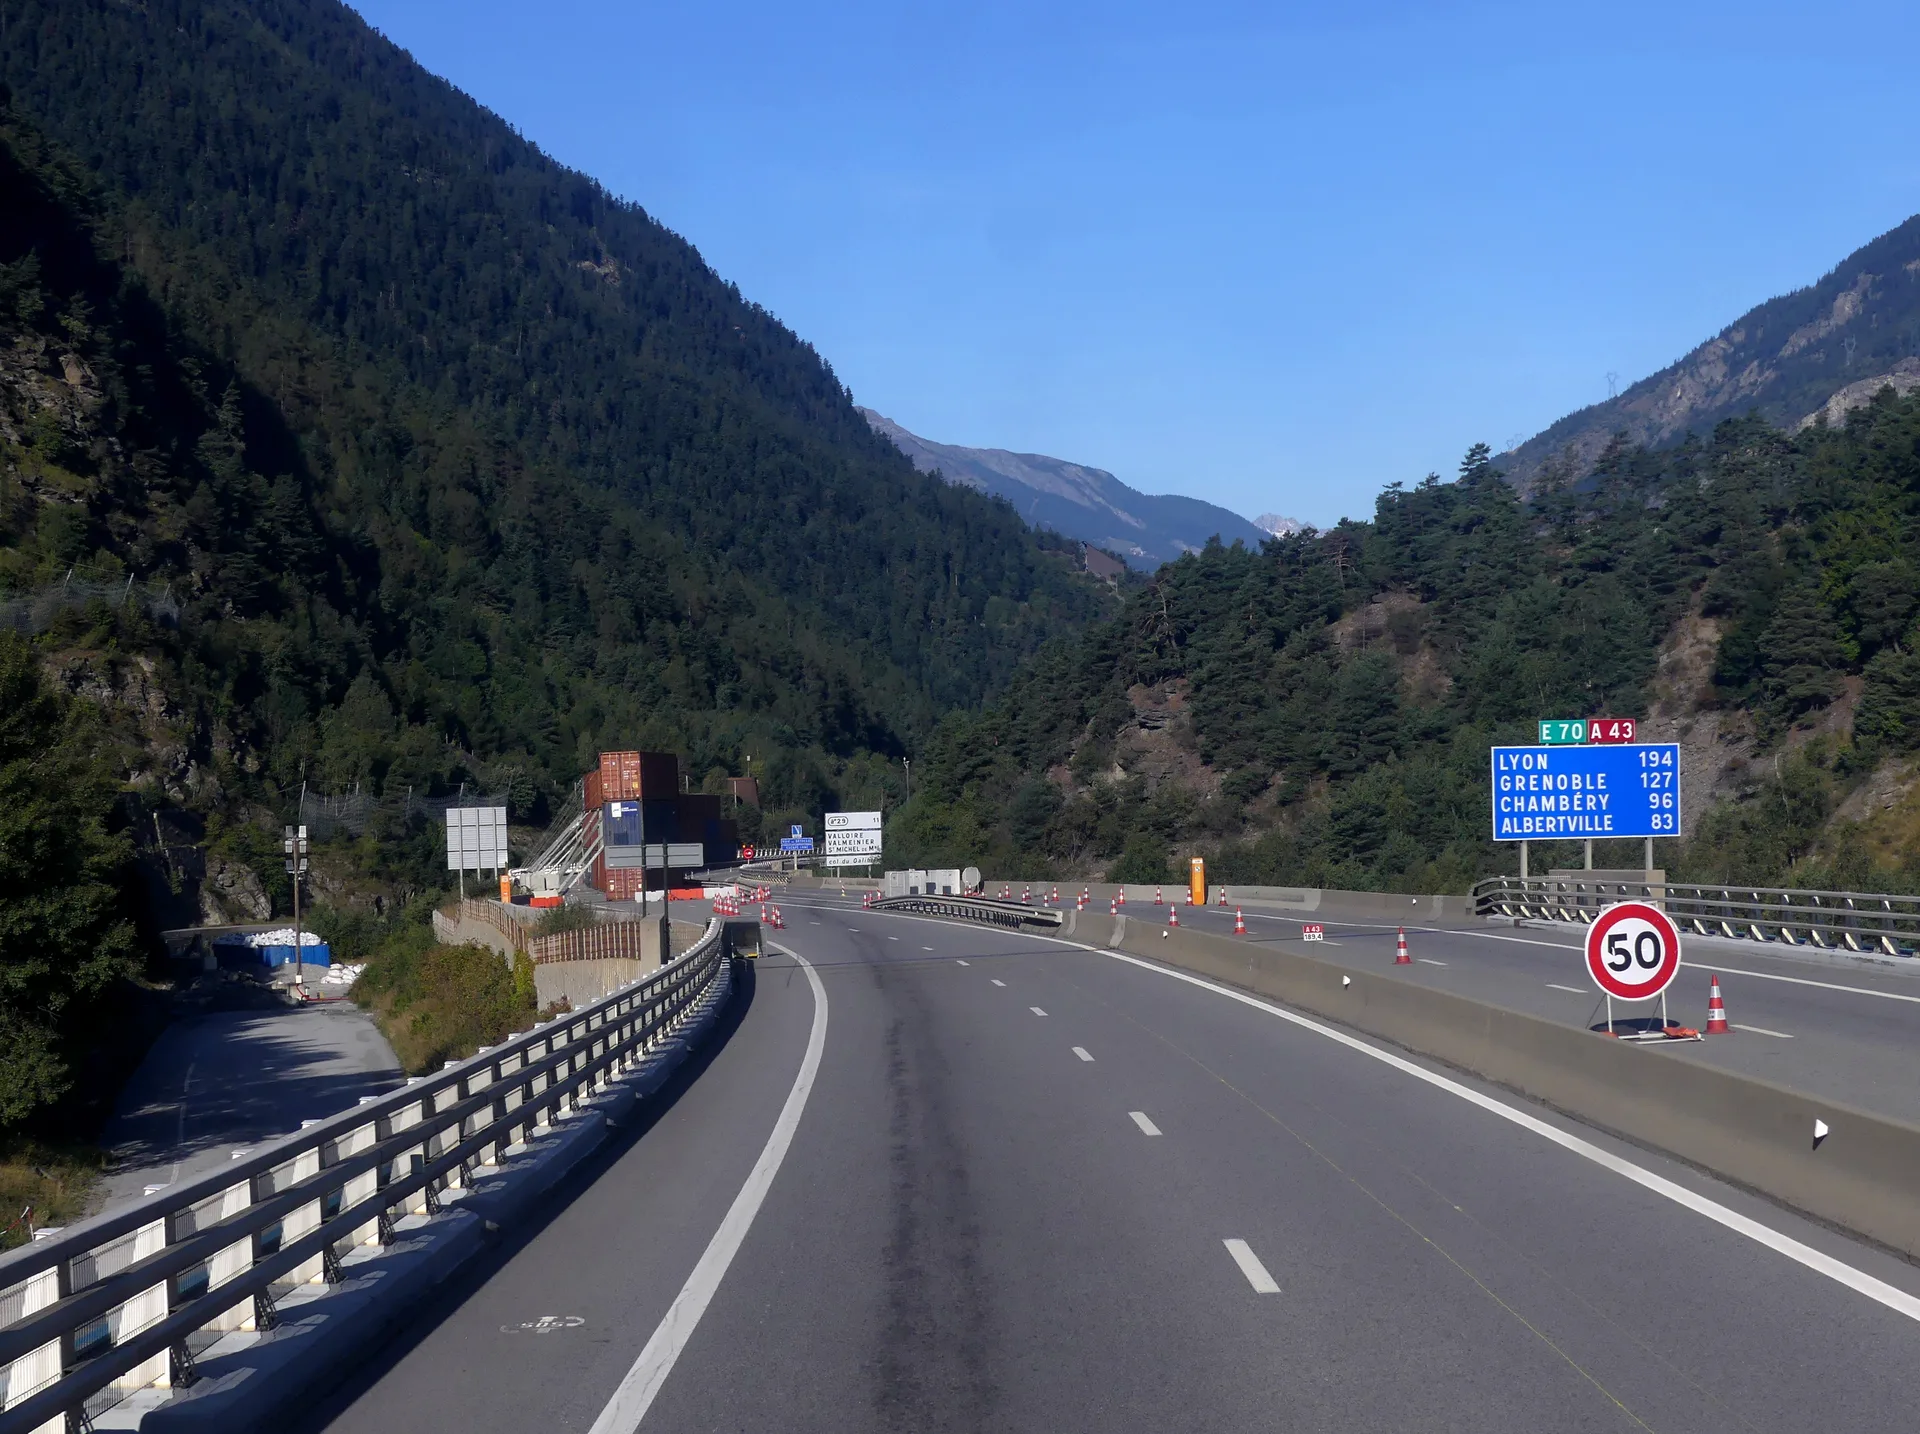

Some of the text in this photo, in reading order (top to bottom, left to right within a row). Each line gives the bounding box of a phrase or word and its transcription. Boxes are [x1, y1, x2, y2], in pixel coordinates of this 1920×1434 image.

[1542, 722, 1583, 740] E 70
[1591, 721, 1633, 739] A 43
[1499, 750, 1673, 771] LYON 194
[1499, 771, 1673, 791] GRENOBLE 127
[1500, 792, 1673, 813] CHAMBÉRY 96
[1501, 813, 1673, 833] ALBERTVILLE 83
[1607, 931, 1661, 972] 50
